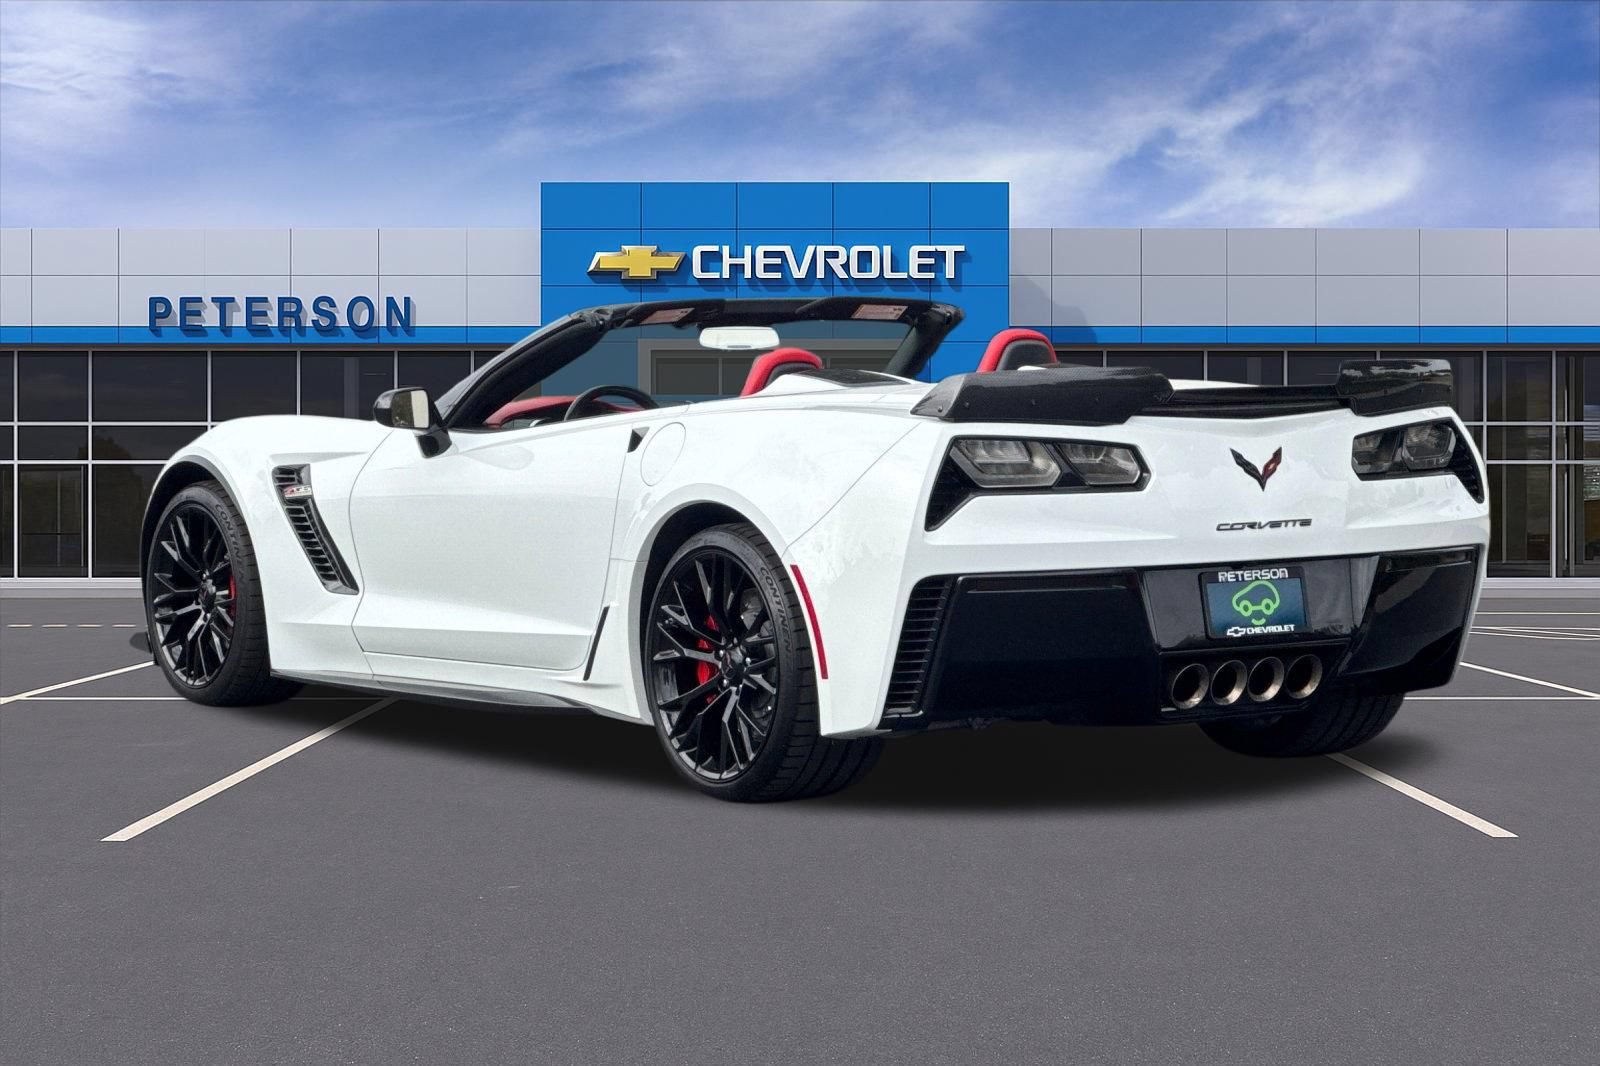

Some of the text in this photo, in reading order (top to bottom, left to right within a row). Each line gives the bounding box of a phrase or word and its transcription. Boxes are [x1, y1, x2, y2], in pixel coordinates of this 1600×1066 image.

[692, 245, 965, 279] CHEVROLET
[148, 295, 412, 332] PETERSON
[1216, 518, 1312, 531] CORVETTE
[1217, 568, 1289, 582] PETERSON
[1246, 624, 1295, 635] CHEVROLET
